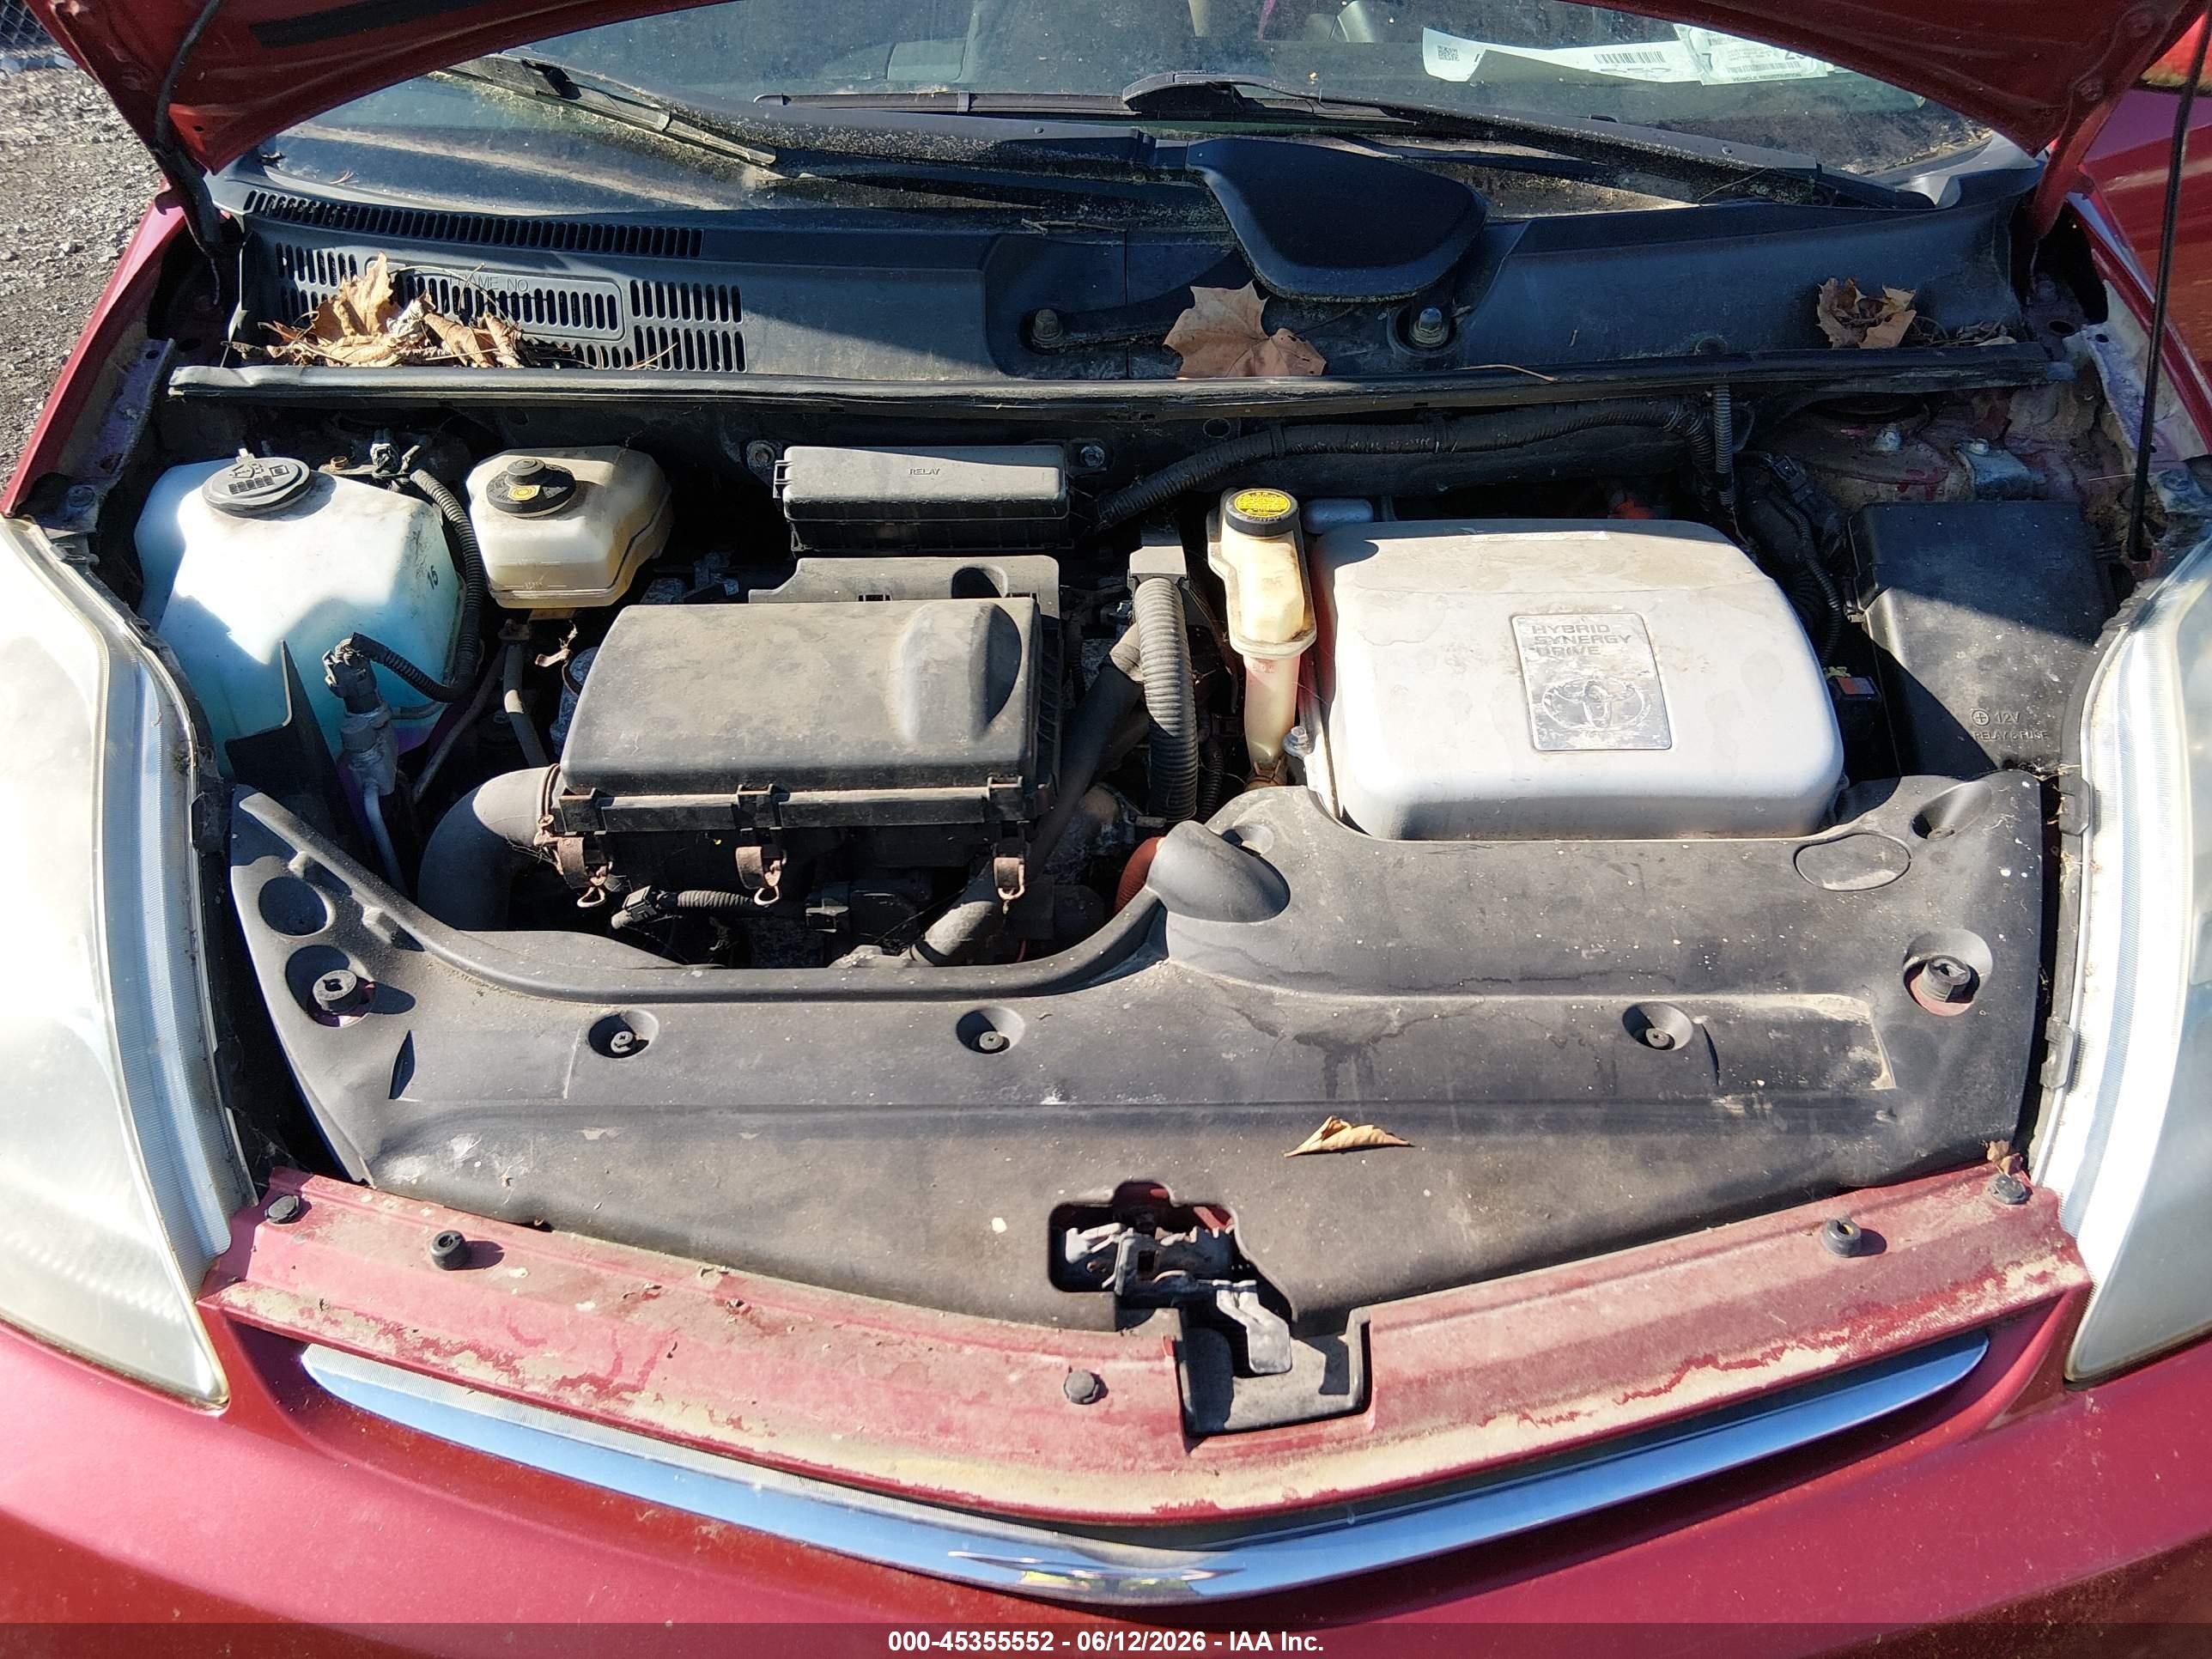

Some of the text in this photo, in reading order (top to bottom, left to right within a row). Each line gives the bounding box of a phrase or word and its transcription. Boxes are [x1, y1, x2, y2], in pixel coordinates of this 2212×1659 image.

[908, 467, 941, 476] RELAY
[1531, 624, 1611, 635] HYBRID
[1533, 635, 1632, 645] SYNERGY
[1535, 646, 1601, 657] DRIVE
[1994, 710, 2021, 723] 12V
[1974, 730, 2008, 740] RELAY
[2019, 729, 2048, 740] FUSE
